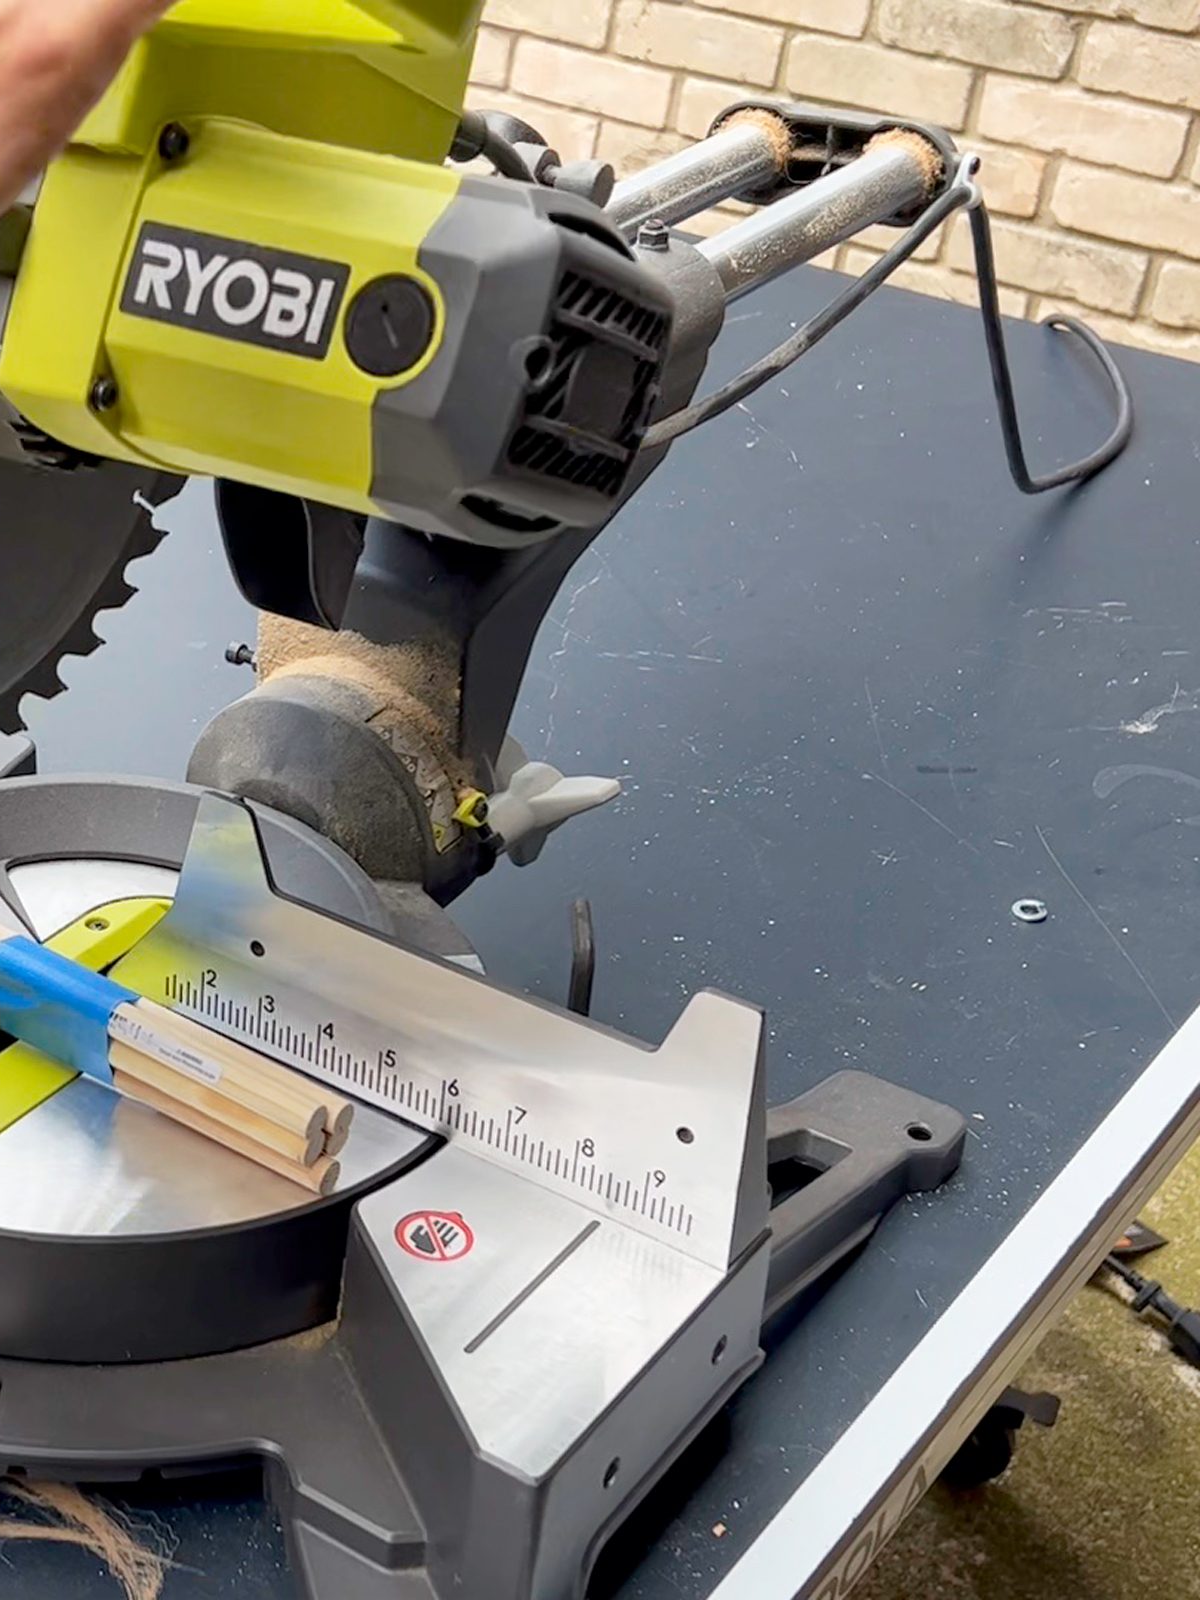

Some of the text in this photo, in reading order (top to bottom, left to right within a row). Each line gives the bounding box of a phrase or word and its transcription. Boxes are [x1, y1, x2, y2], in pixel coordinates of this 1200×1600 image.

[133, 239, 336, 345] RYOBI
[206, 969, 667, 1188] 2 3 4 5 6 7 8 9
